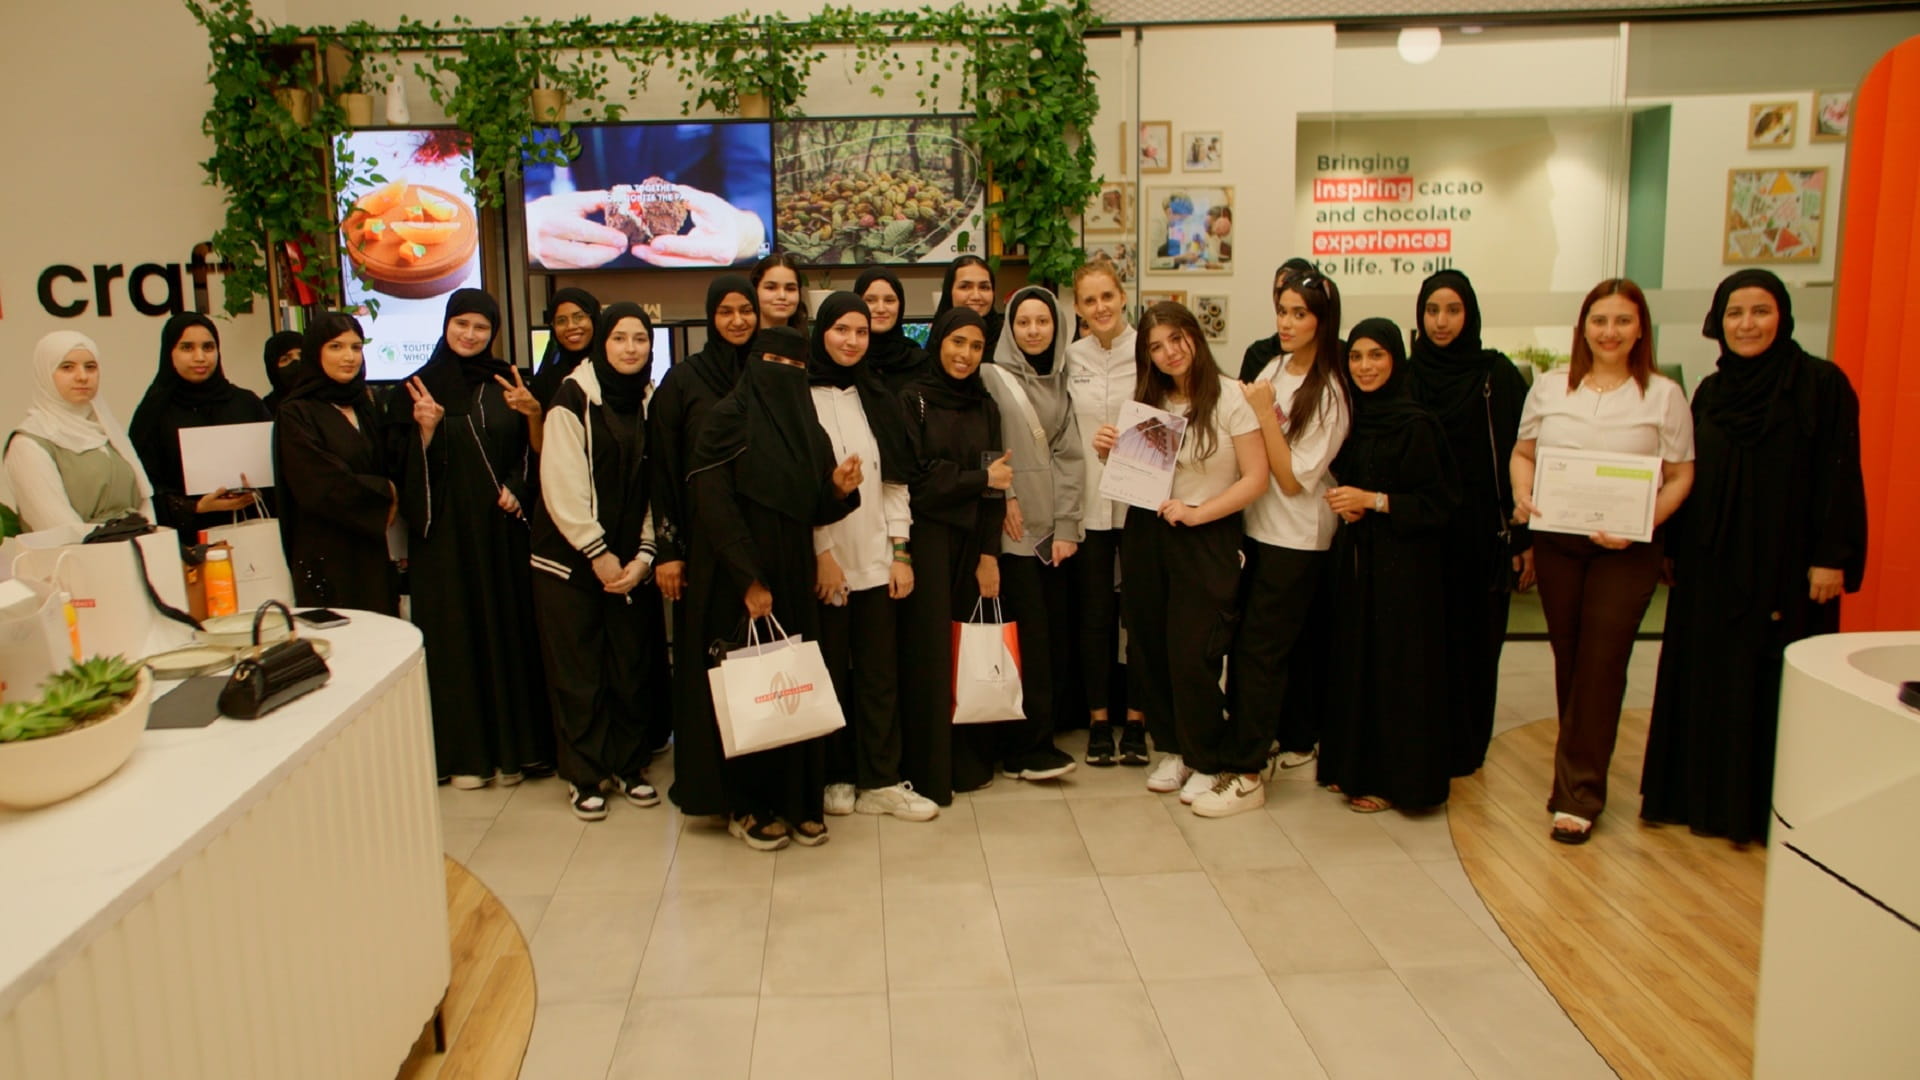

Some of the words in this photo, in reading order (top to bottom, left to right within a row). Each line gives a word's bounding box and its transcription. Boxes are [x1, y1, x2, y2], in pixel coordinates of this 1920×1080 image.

[1317, 154, 1410, 174] Bringing
[1315, 180, 1412, 202] inspiring
[1418, 181, 1484, 195] cacao
[1316, 206, 1355, 223] and
[1363, 204, 1472, 223] chocolate
[1315, 231, 1448, 253] experiences
[1344, 257, 1383, 275] life.
[1390, 257, 1415, 274] To
